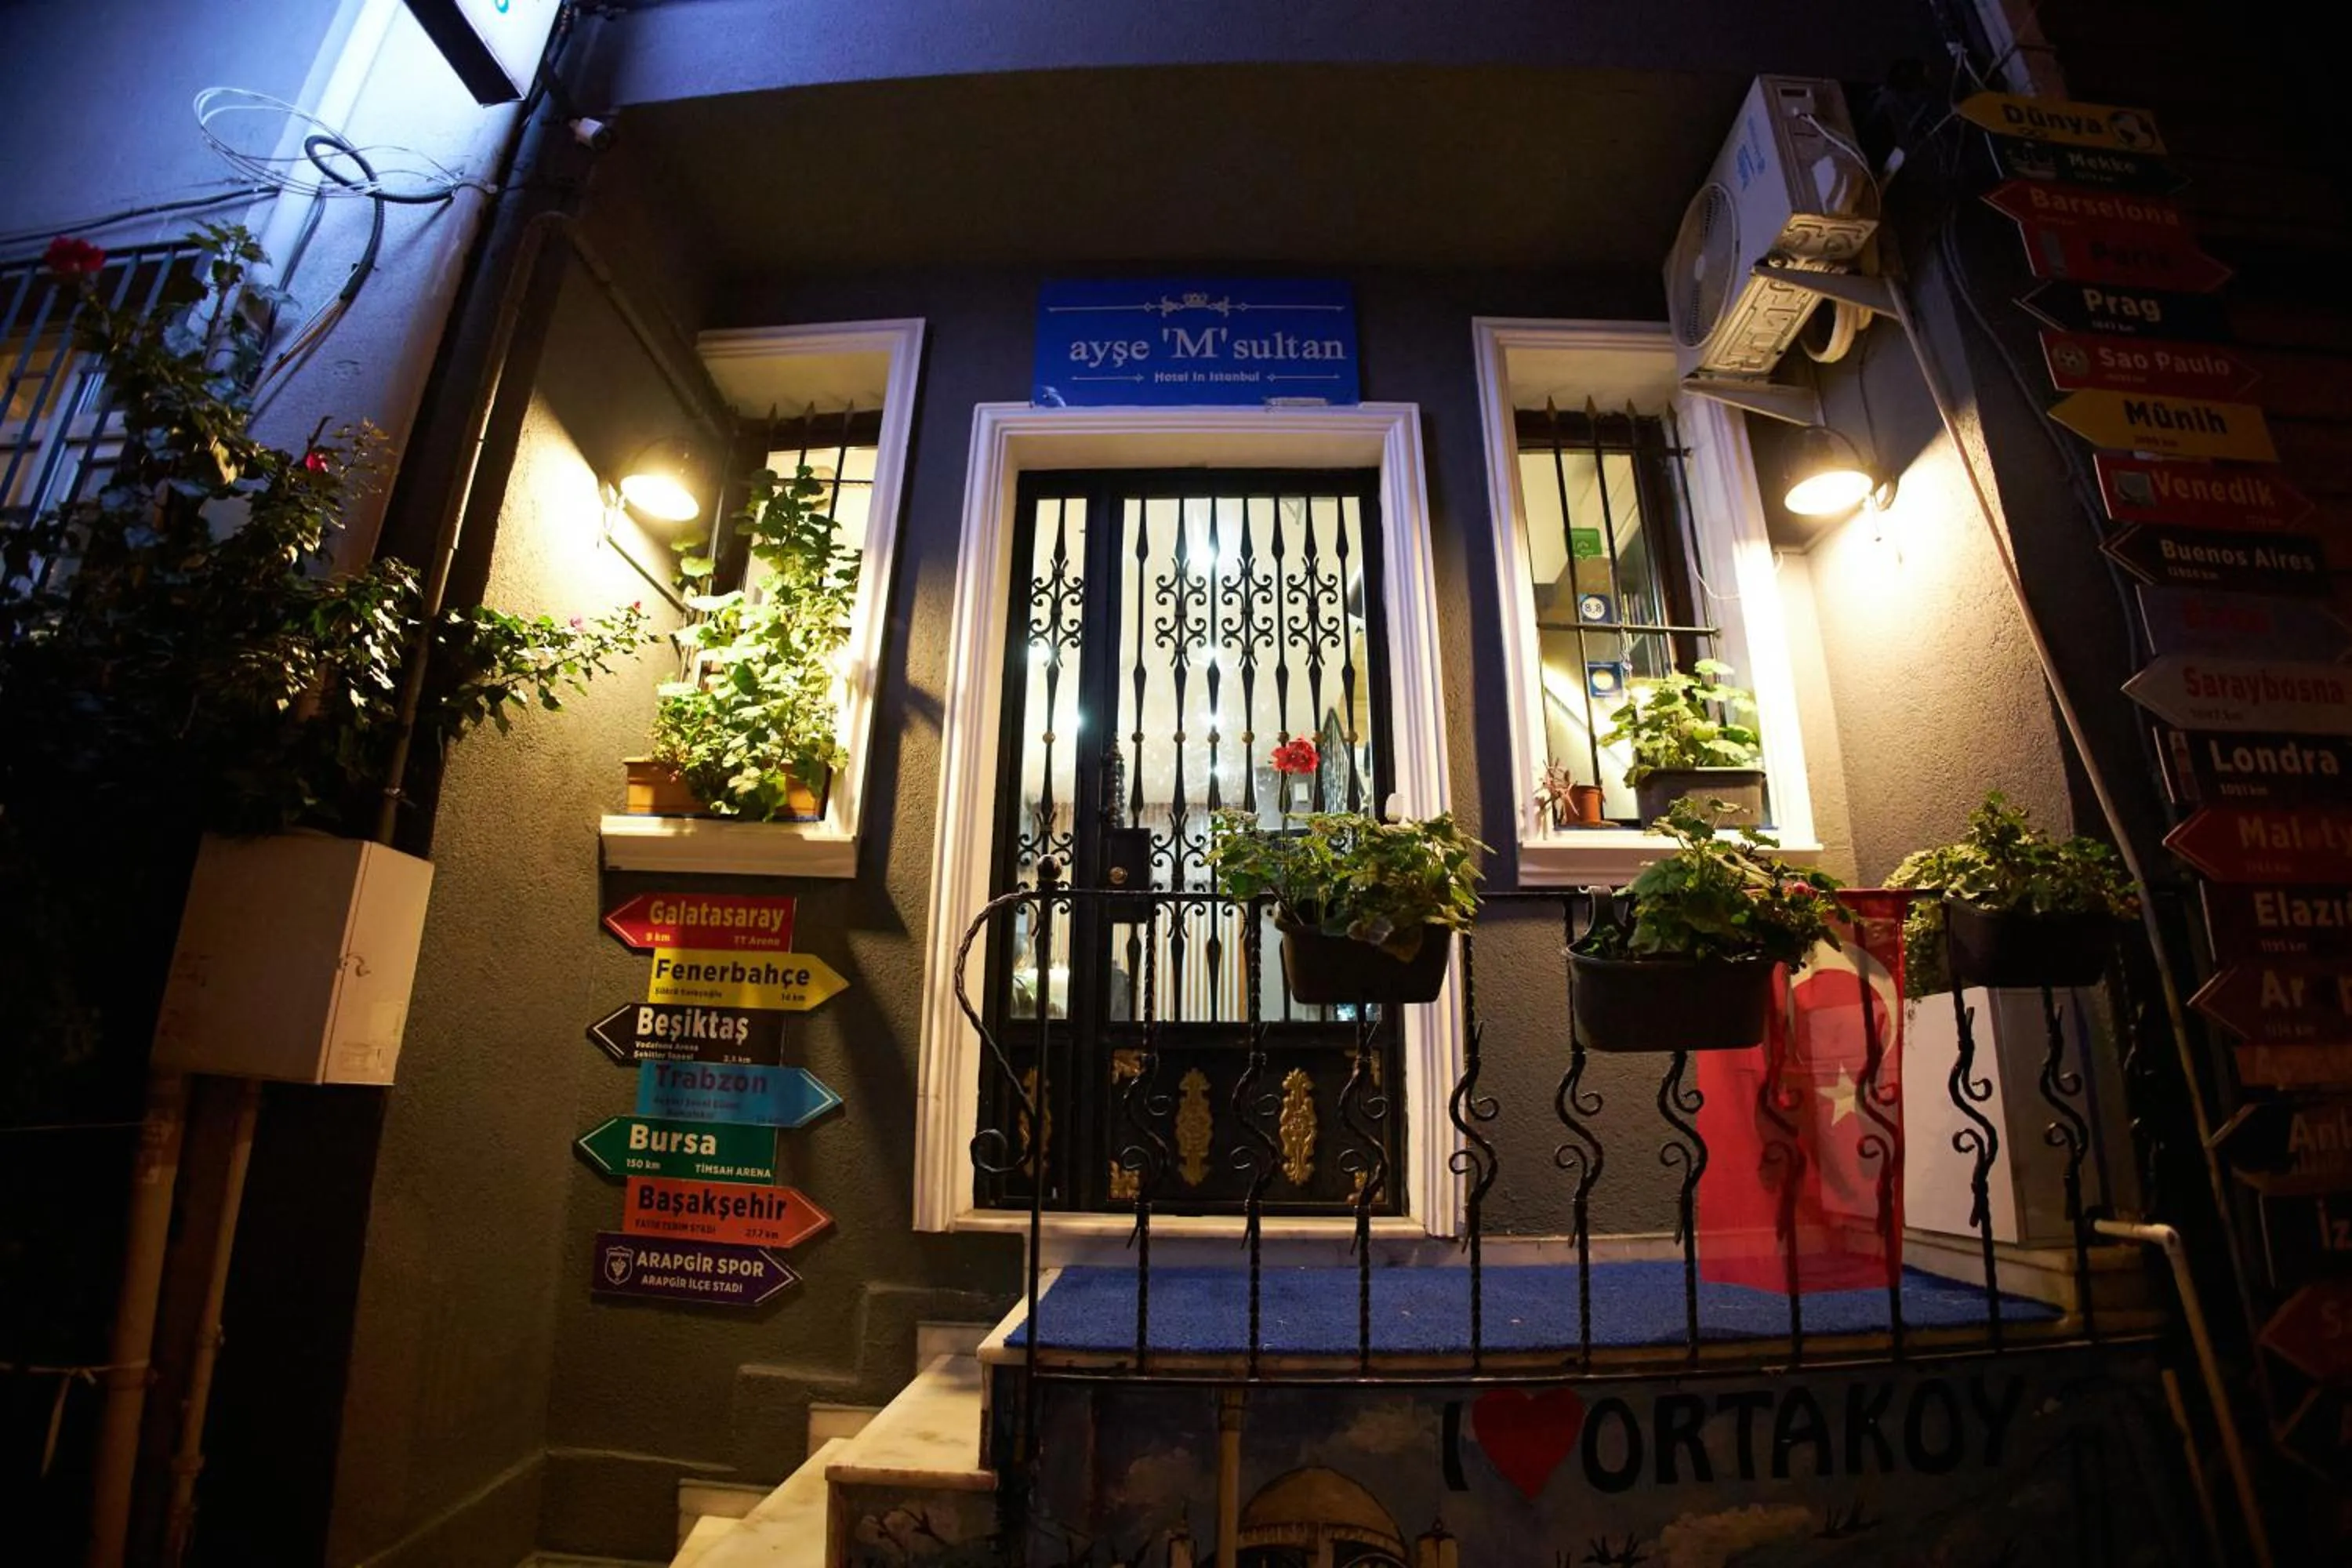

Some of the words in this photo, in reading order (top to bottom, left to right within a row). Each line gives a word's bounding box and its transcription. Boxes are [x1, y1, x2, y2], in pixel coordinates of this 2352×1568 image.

[2002, 103, 2102, 135] Dünya
[2067, 151, 2137, 174] Mekke
[2029, 186, 2181, 227] Barselona
[2082, 288, 2161, 323] Prag
[1069, 339, 1151, 368] ayşe
[1233, 332, 1347, 361] sultan
[2098, 347, 2149, 370] Sao
[2154, 350, 2230, 376] Paulo
[1154, 372, 1189, 383] Hotel
[1209, 372, 1260, 383] Istanbul
[2124, 399, 2228, 434] Münih
[2151, 469, 2276, 508] Venedik
[2160, 538, 2249, 566] Buenos
[2255, 546, 2315, 573] Aires
[2183, 666, 2346, 706] Saraybosna
[2209, 739, 2339, 776] Londra
[649, 899, 785, 931] Galatasaray
[655, 958, 811, 990] Fenerbahçe
[636, 1006, 750, 1046] Beşiktaş
[655, 1063, 768, 1094] Trabzon
[628, 1122, 717, 1156] Bursa
[695, 1163, 734, 1177] TİMSAH
[735, 1166, 772, 1178] ARENA
[638, 1184, 787, 1221] Başakşehir
[636, 1249, 713, 1275] ARAPGİR
[717, 1258, 764, 1278] SPOR
[641, 1274, 687, 1290] ARAPGİR
[688, 1278, 711, 1294] İLÇE
[712, 1279, 743, 1294] STADI
[1582, 1374, 2027, 1494] ORTAKOY
